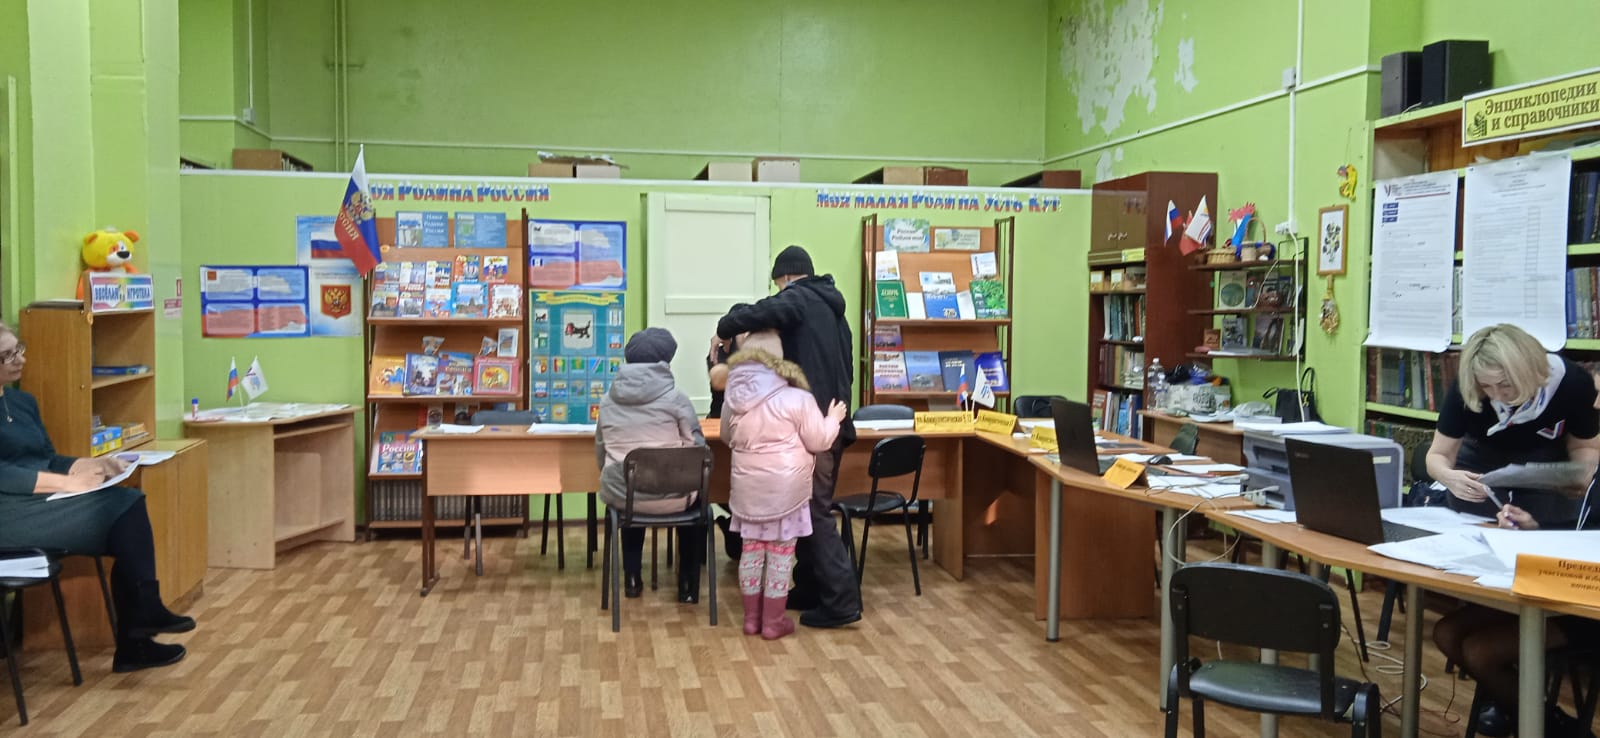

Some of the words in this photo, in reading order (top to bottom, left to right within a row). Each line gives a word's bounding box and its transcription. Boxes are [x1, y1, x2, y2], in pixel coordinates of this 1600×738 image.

[1485, 81, 1598, 115] Энциклопедии
[1491, 118, 1500, 131] и
[1504, 99, 1600, 130] справочники
